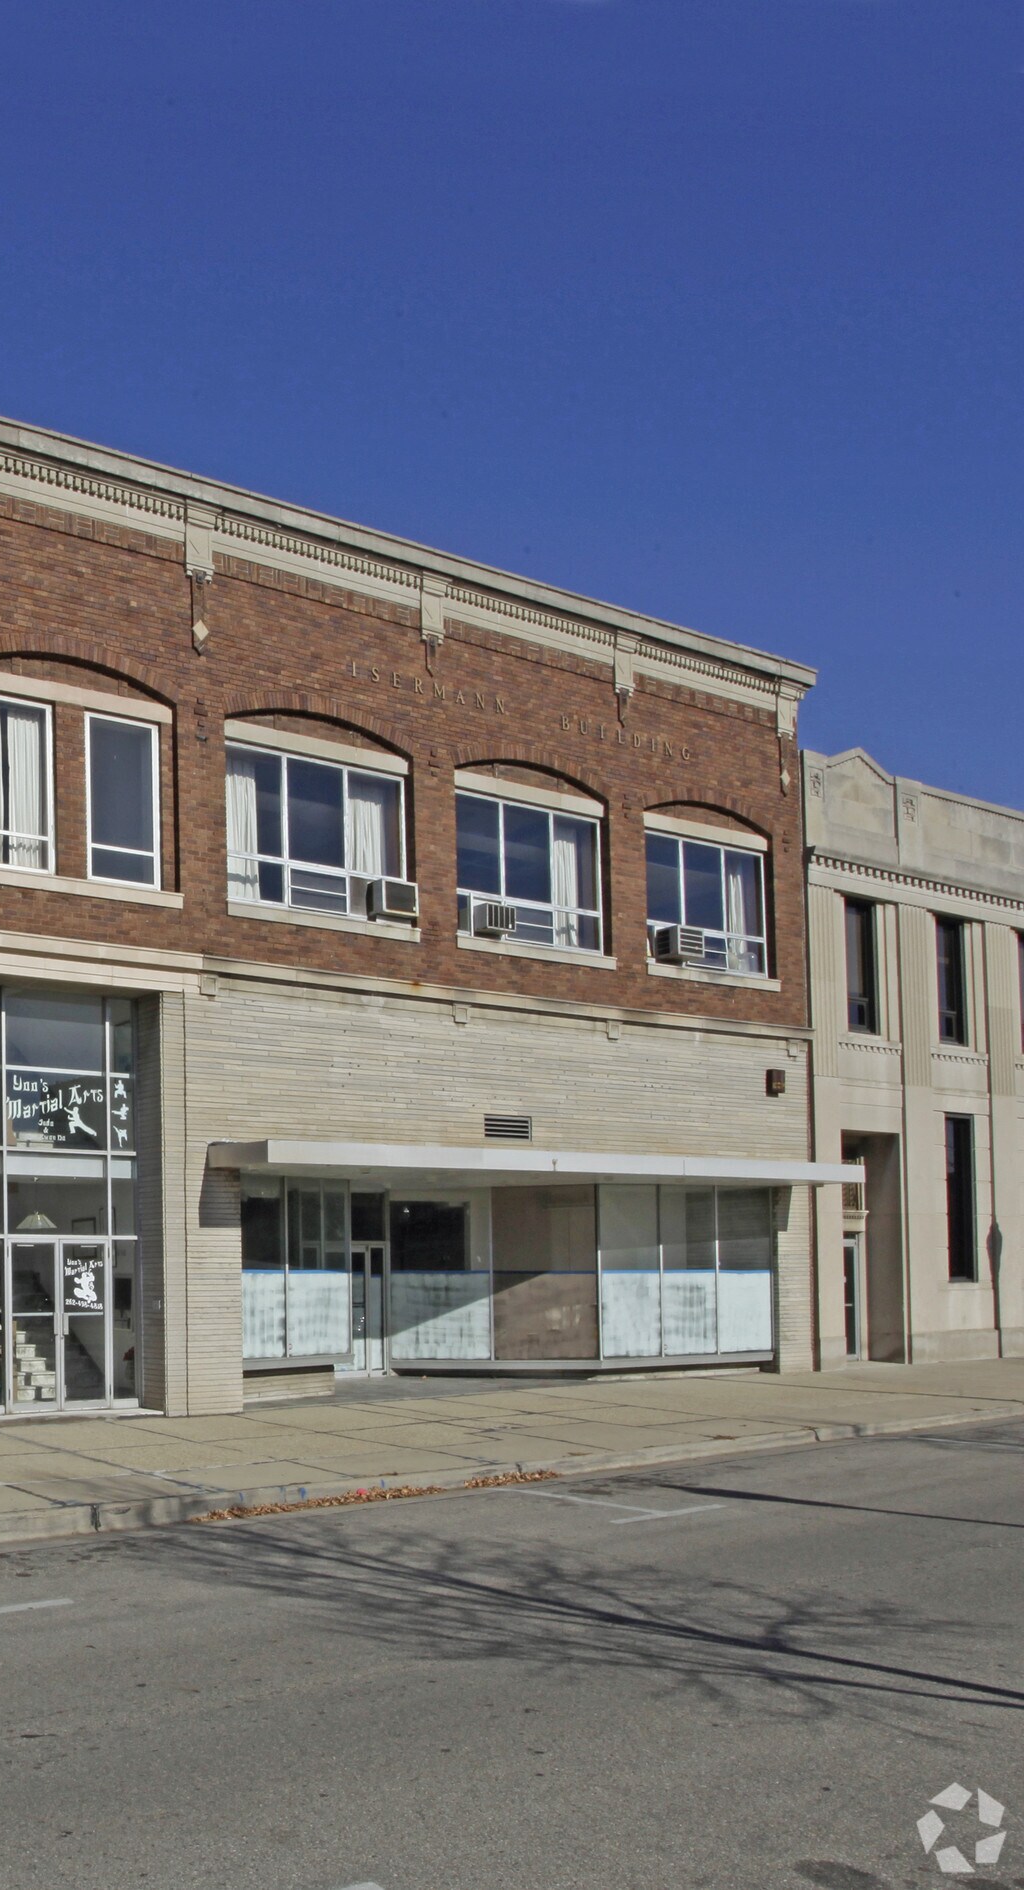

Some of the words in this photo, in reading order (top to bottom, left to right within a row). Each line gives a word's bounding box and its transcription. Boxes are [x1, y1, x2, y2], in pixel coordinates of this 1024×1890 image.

[351, 661, 505, 714] ISERMANN
[561, 716, 691, 760] BUILDING
[6, 1089, 63, 1120] Martial
